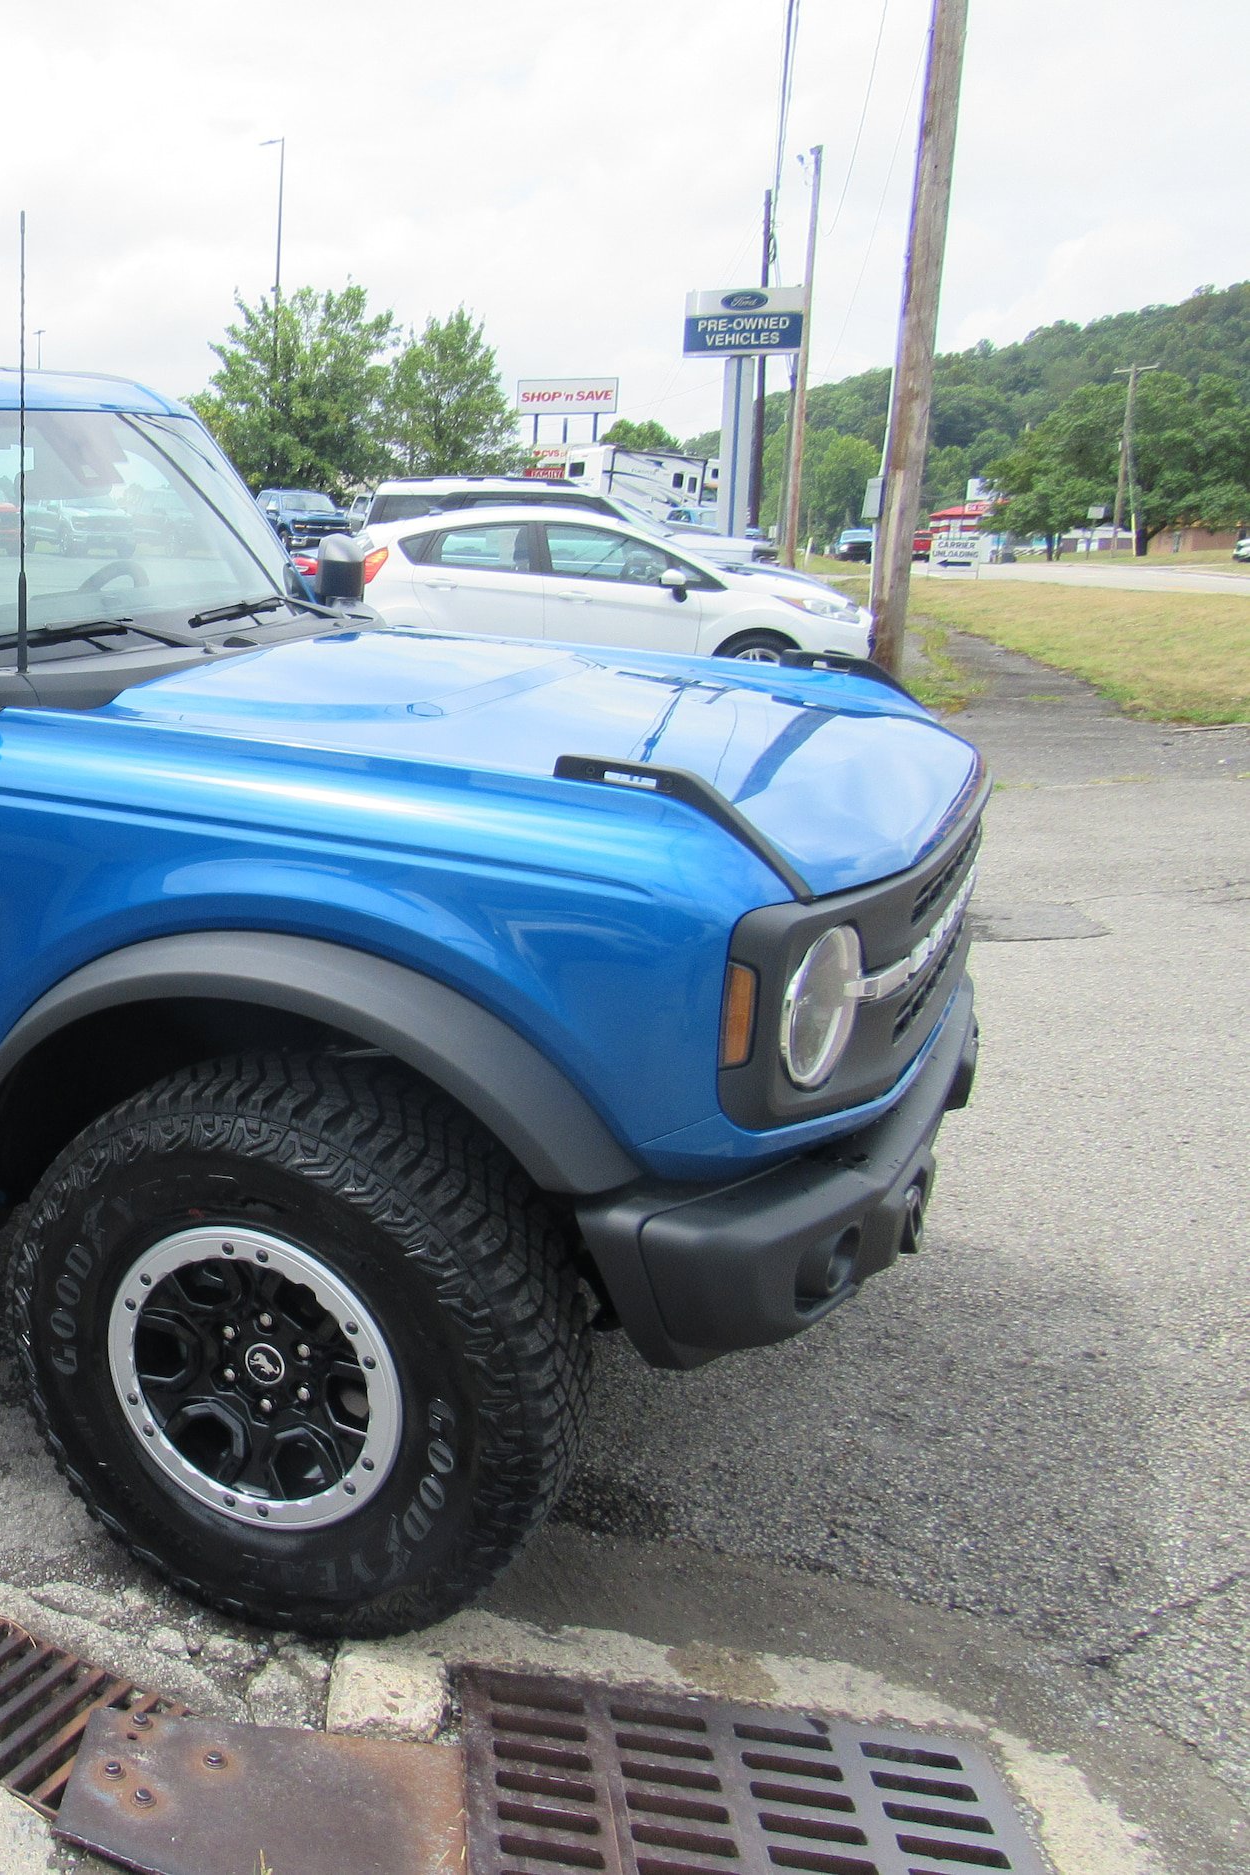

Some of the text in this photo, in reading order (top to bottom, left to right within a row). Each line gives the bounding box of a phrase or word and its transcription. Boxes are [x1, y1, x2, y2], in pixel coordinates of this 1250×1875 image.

[697, 317, 790, 332] PRE-OWNED
[705, 332, 780, 347] VEHICLES
[521, 391, 562, 403] SHOP
[576, 390, 614, 402] SAVE
[541, 450, 559, 458] CVS
[937, 541, 976, 550] CARRIER
[932, 550, 979, 559] UNLOADING
